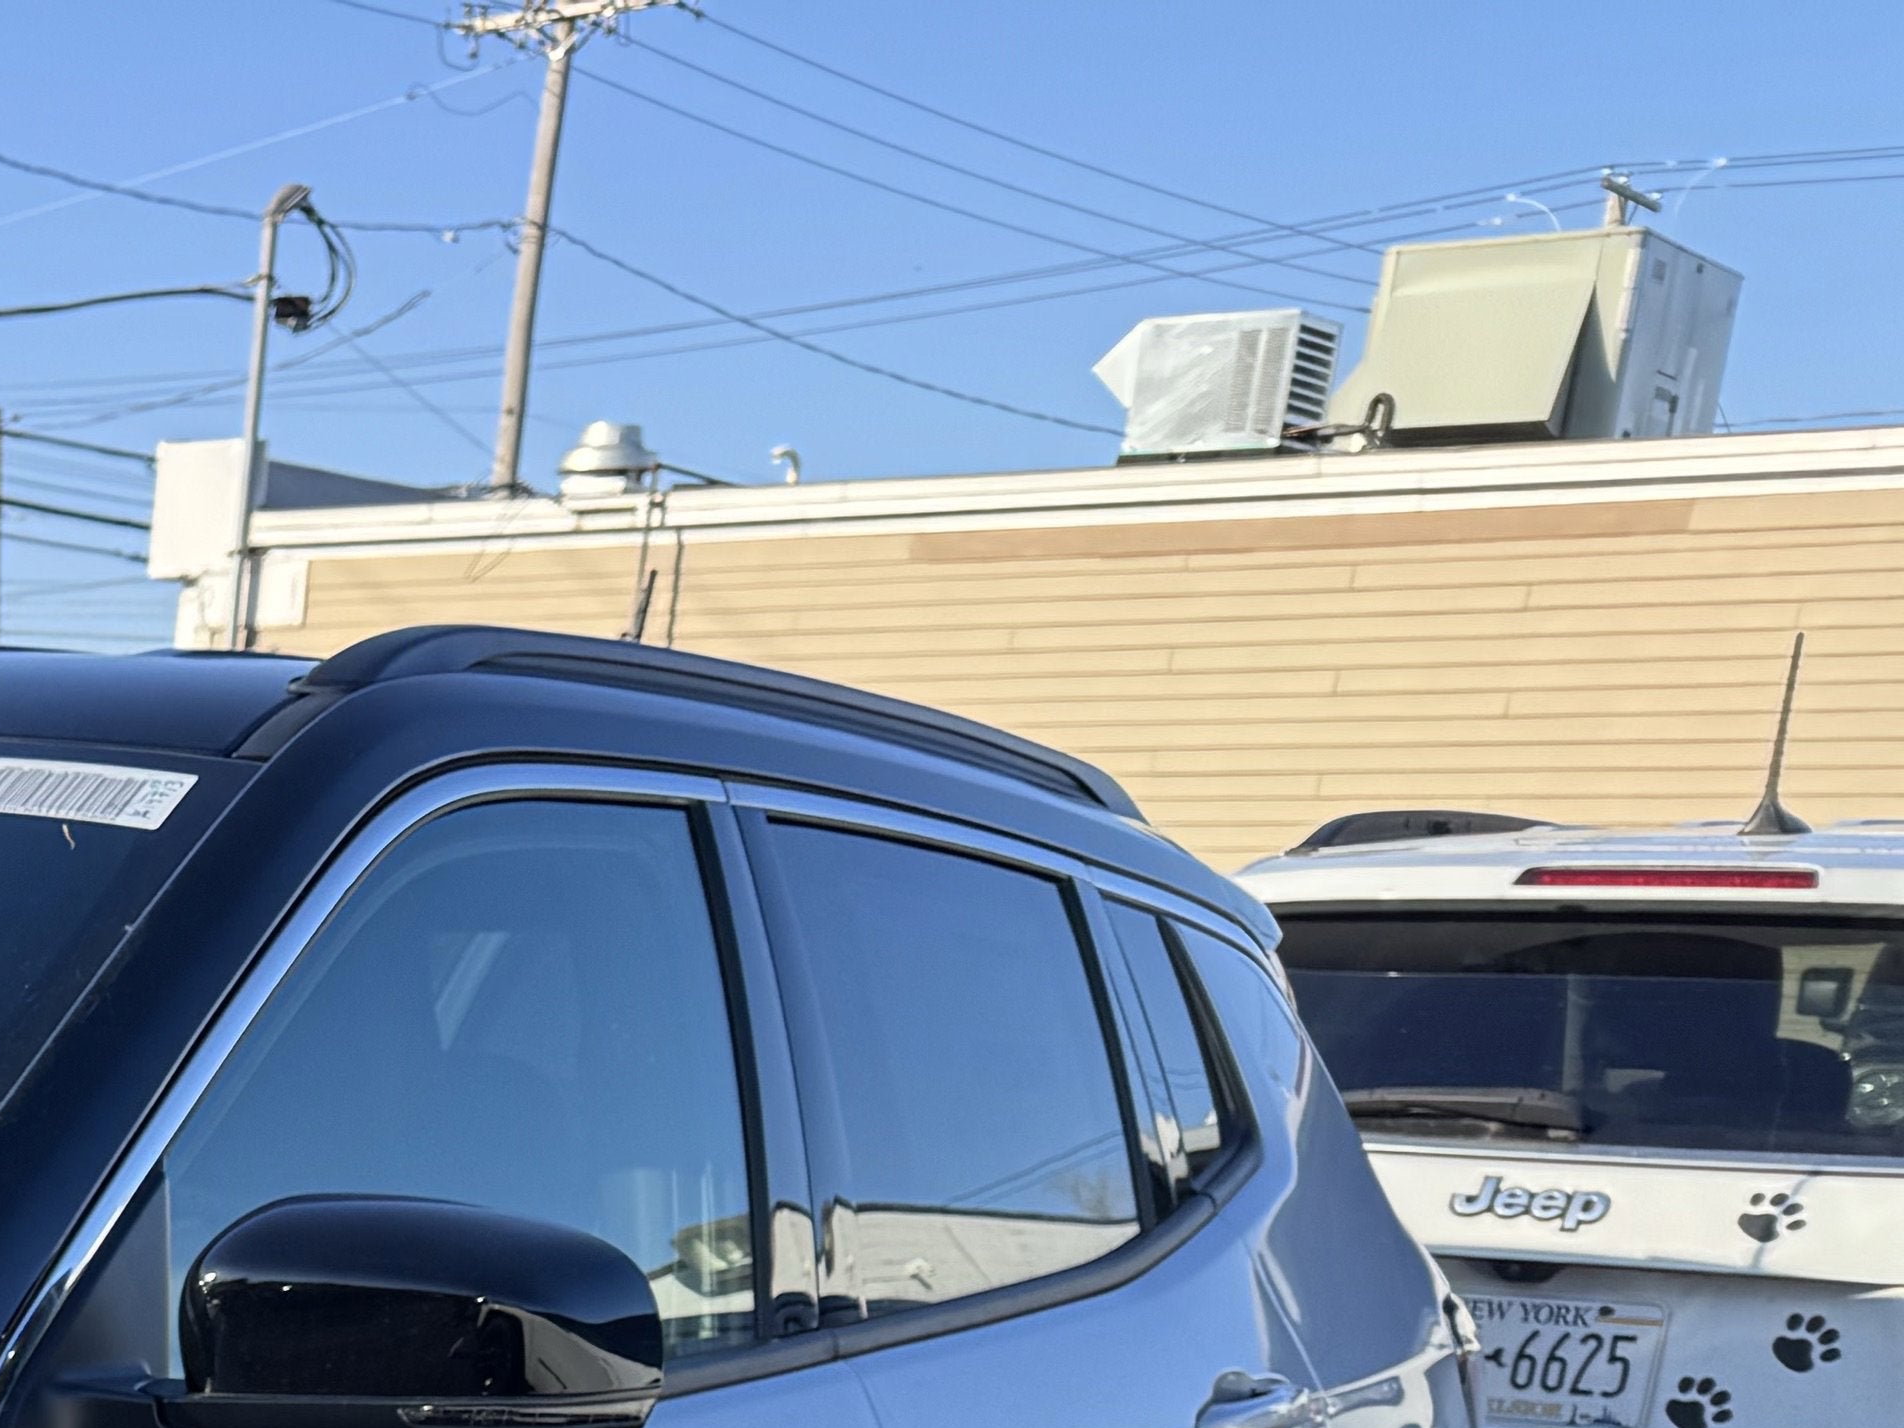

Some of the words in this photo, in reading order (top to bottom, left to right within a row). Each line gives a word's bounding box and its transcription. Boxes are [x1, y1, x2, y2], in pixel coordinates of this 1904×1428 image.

[1449, 1174, 1612, 1233] Jeep
[1467, 1298, 1513, 1321] EW
[1519, 1300, 1593, 1328] YORK
[1509, 1329, 1639, 1399] 6625
